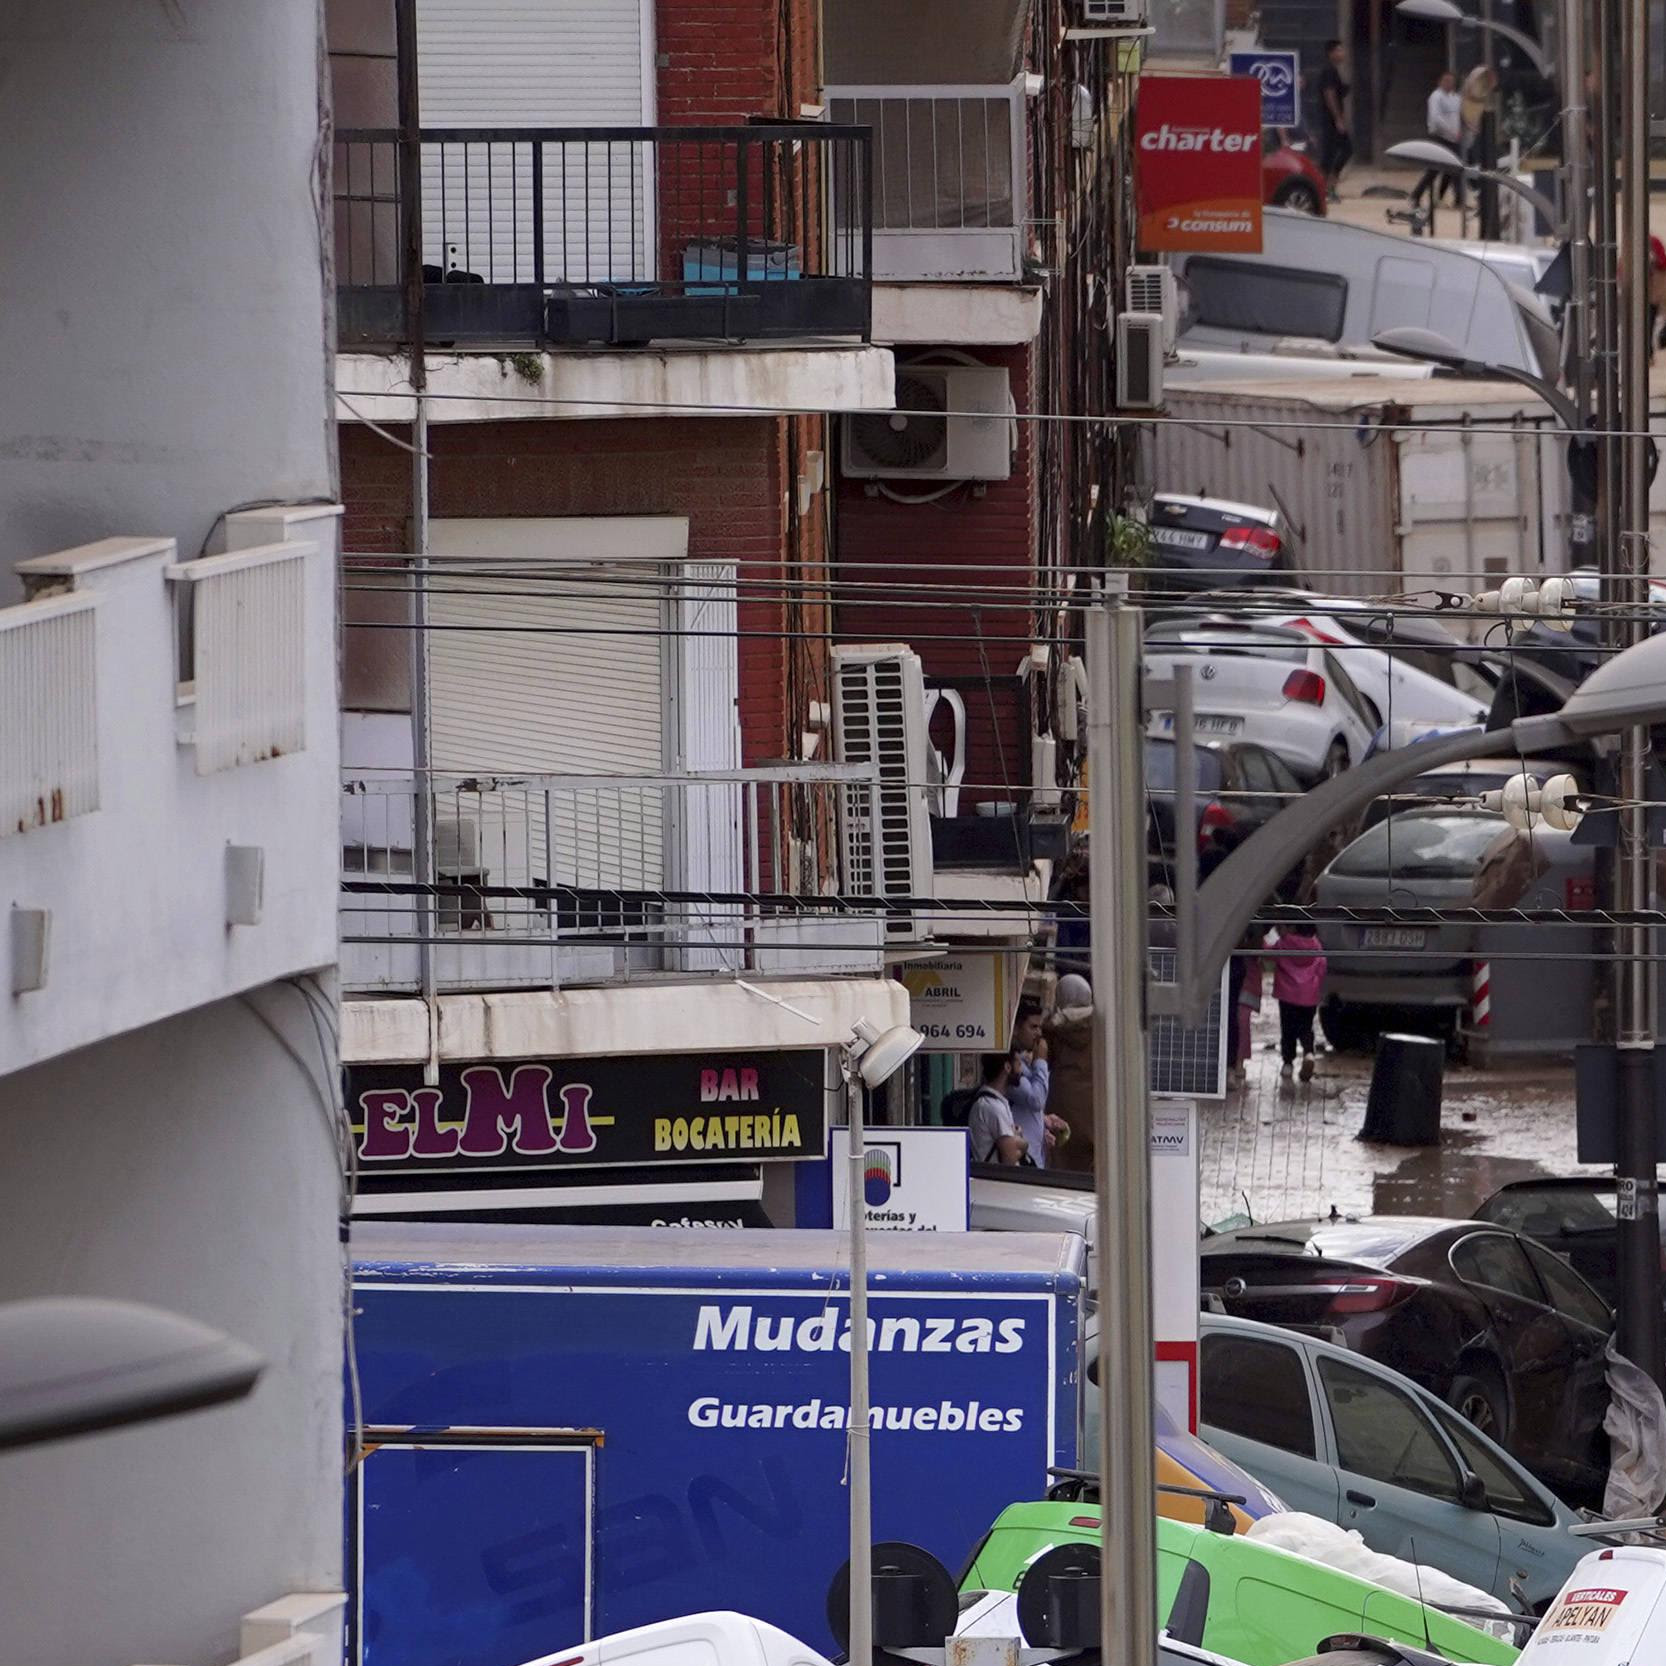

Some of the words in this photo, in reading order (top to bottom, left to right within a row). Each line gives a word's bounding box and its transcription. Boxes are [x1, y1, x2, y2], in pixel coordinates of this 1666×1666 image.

[1140, 124, 1258, 152] charter
[1180, 219, 1253, 233] consum
[903, 961, 963, 971] Inmobiliaria
[925, 987, 961, 998] ABRIL
[920, 1024, 950, 1039] 964
[956, 1024, 986, 1039] 694
[701, 1067, 760, 1102] BAR
[654, 1107, 802, 1152] BOCATERÍA
[909, 1212, 917, 1225] y
[692, 1305, 1026, 1354] Mudanzas
[688, 1397, 1024, 1432] Guardamuebles
[1552, 1605, 1612, 1628] APELYAN
